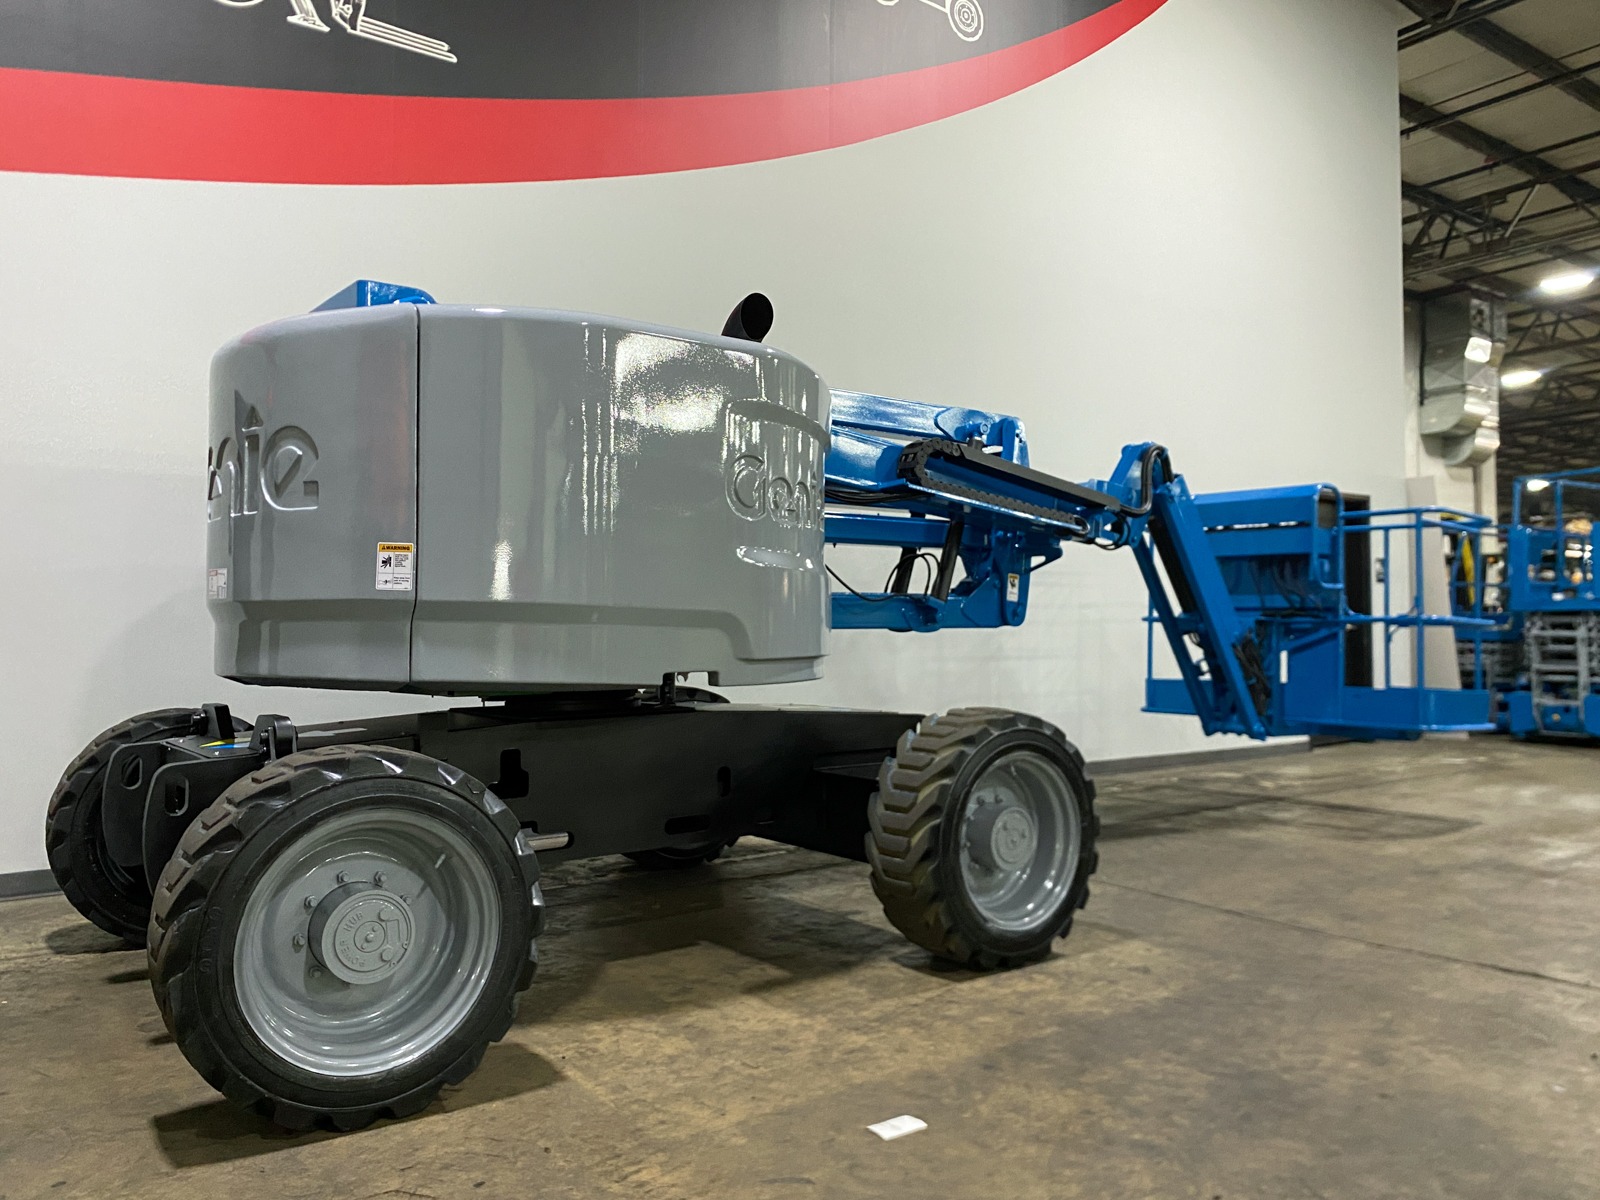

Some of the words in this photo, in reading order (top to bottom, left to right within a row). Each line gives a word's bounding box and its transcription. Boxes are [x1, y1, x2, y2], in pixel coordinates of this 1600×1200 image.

[208, 406, 319, 522] nie
[725, 454, 824, 531] Geni
[343, 912, 363, 932] HUB
